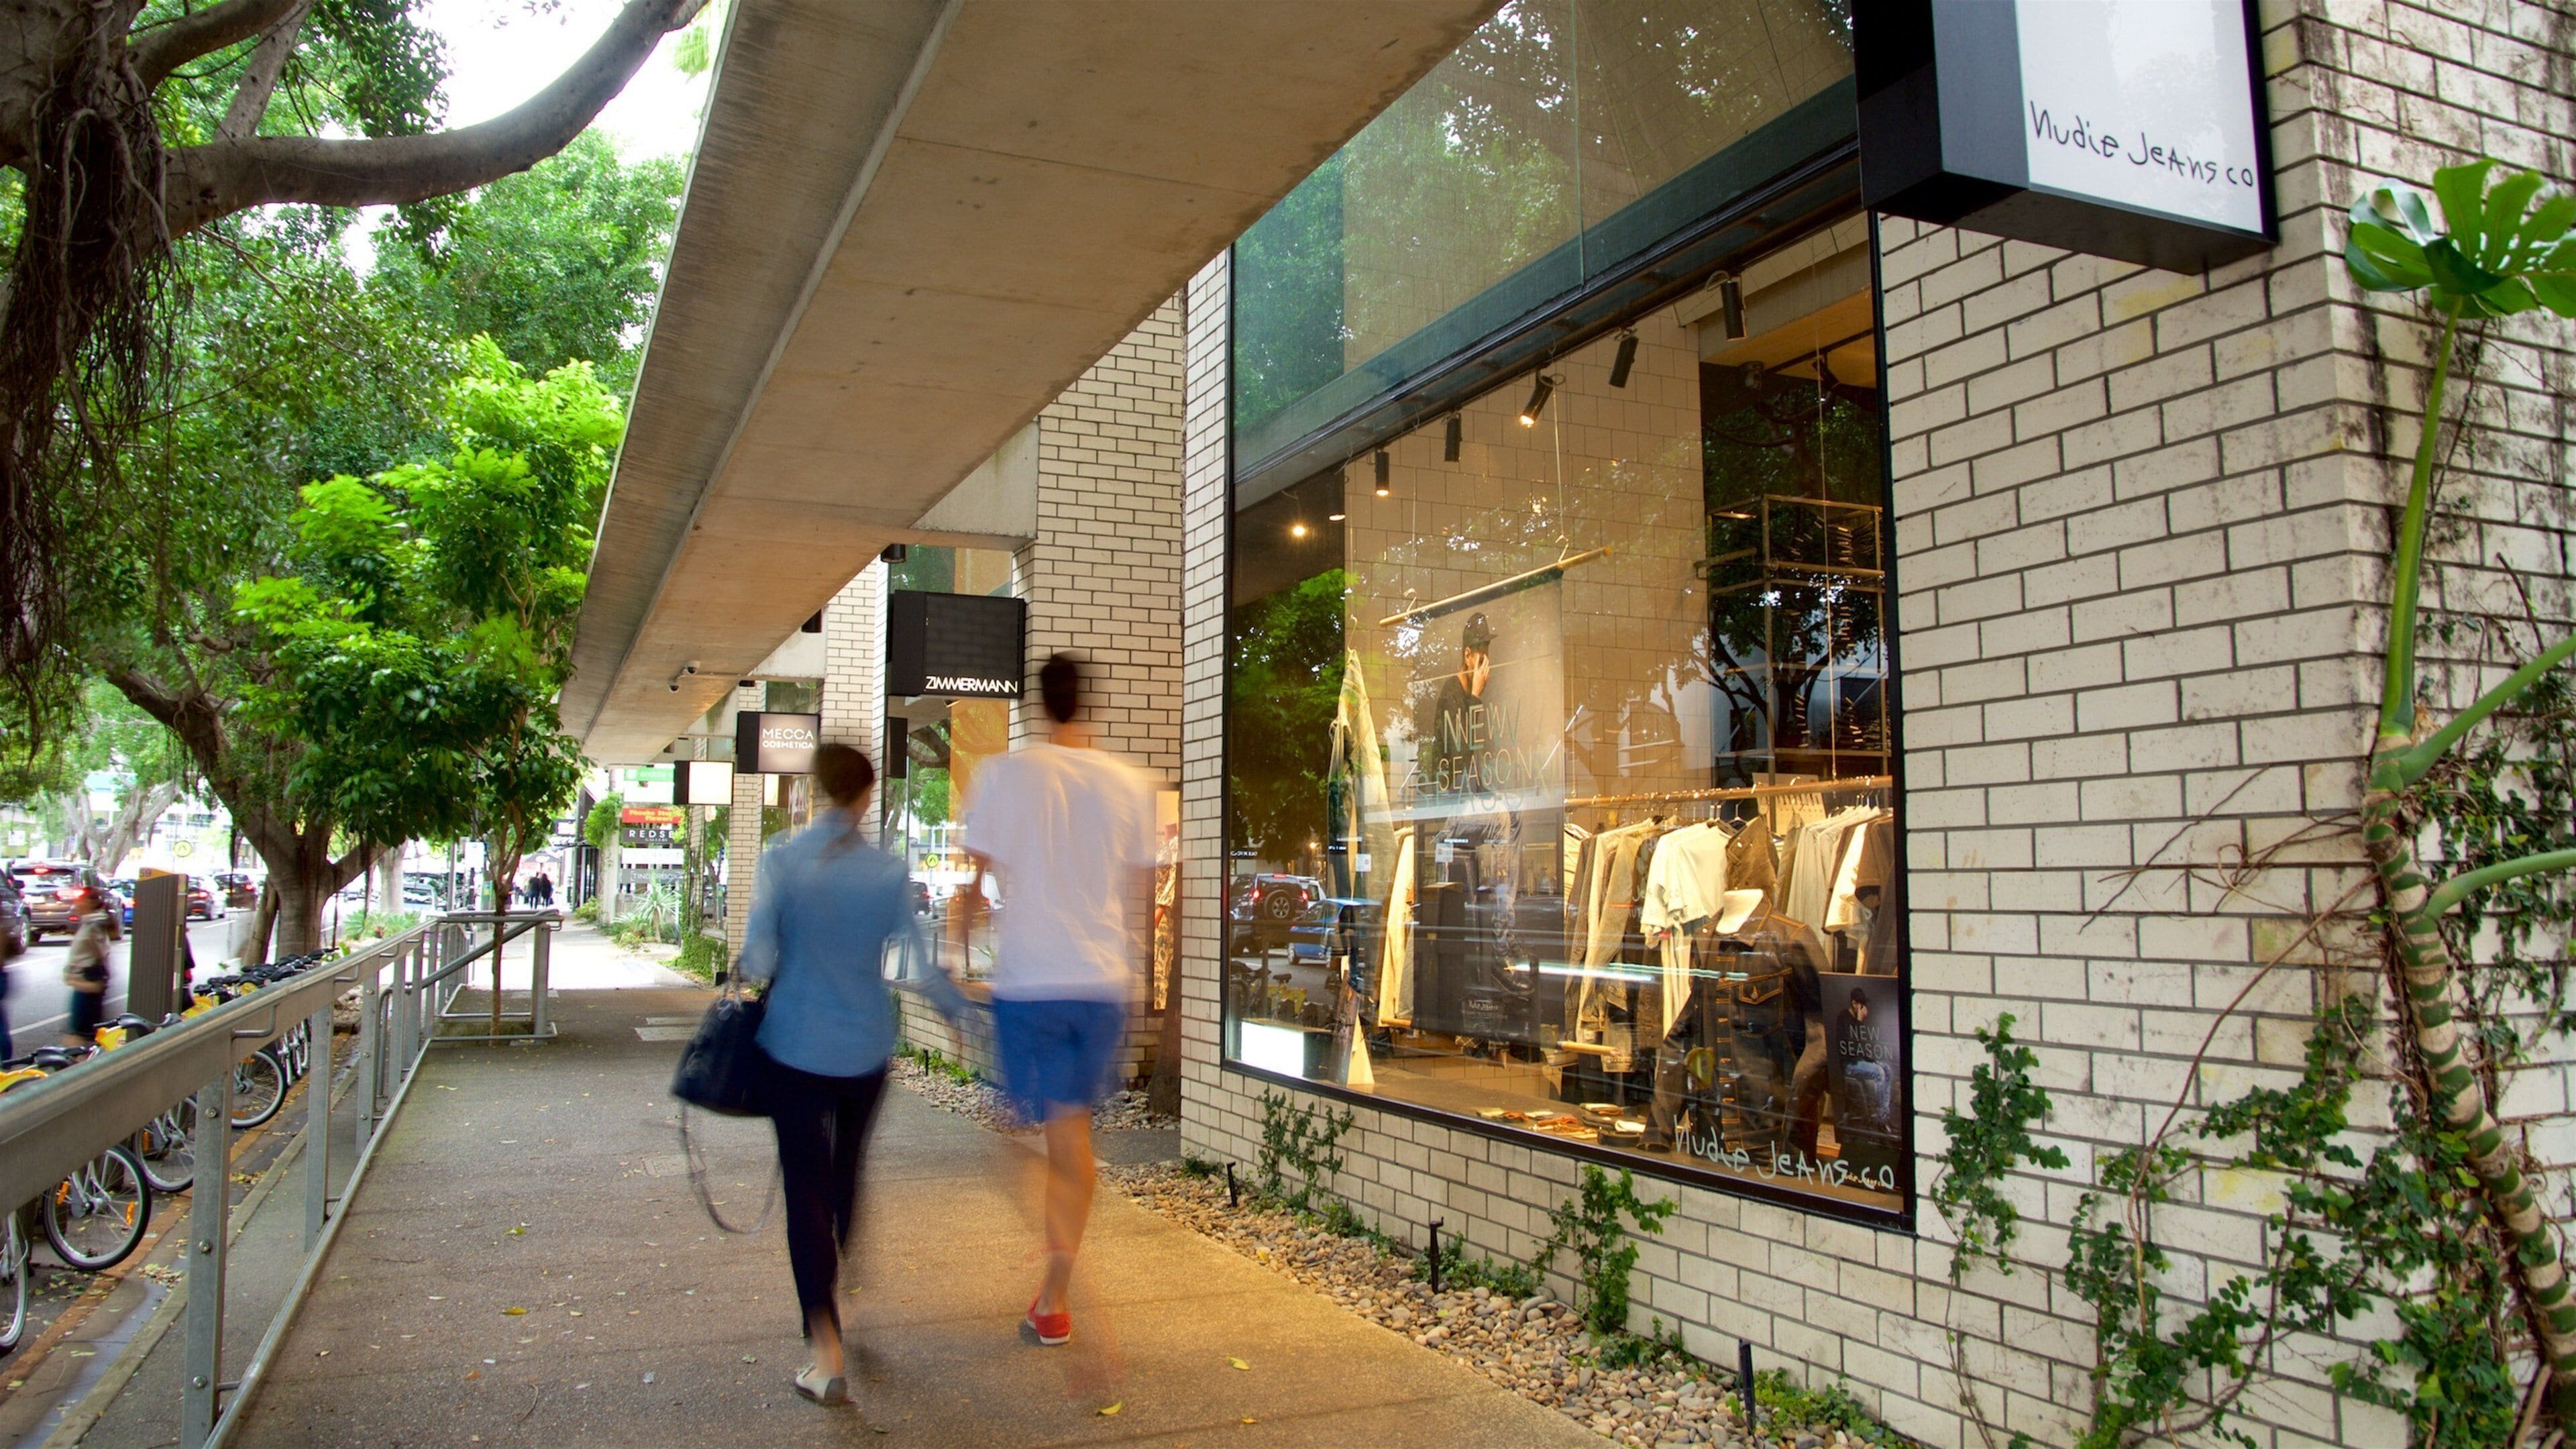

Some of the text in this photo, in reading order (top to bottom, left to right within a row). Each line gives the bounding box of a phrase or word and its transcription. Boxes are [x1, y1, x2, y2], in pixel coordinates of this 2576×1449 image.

[925, 676, 1018, 693] ZIMMERMANN
[762, 728, 814, 740] MECCA
[762, 740, 814, 749] COSMETICA
[1849, 1024, 1880, 1041] NEW
[1839, 1040, 1894, 1061] SEASON
